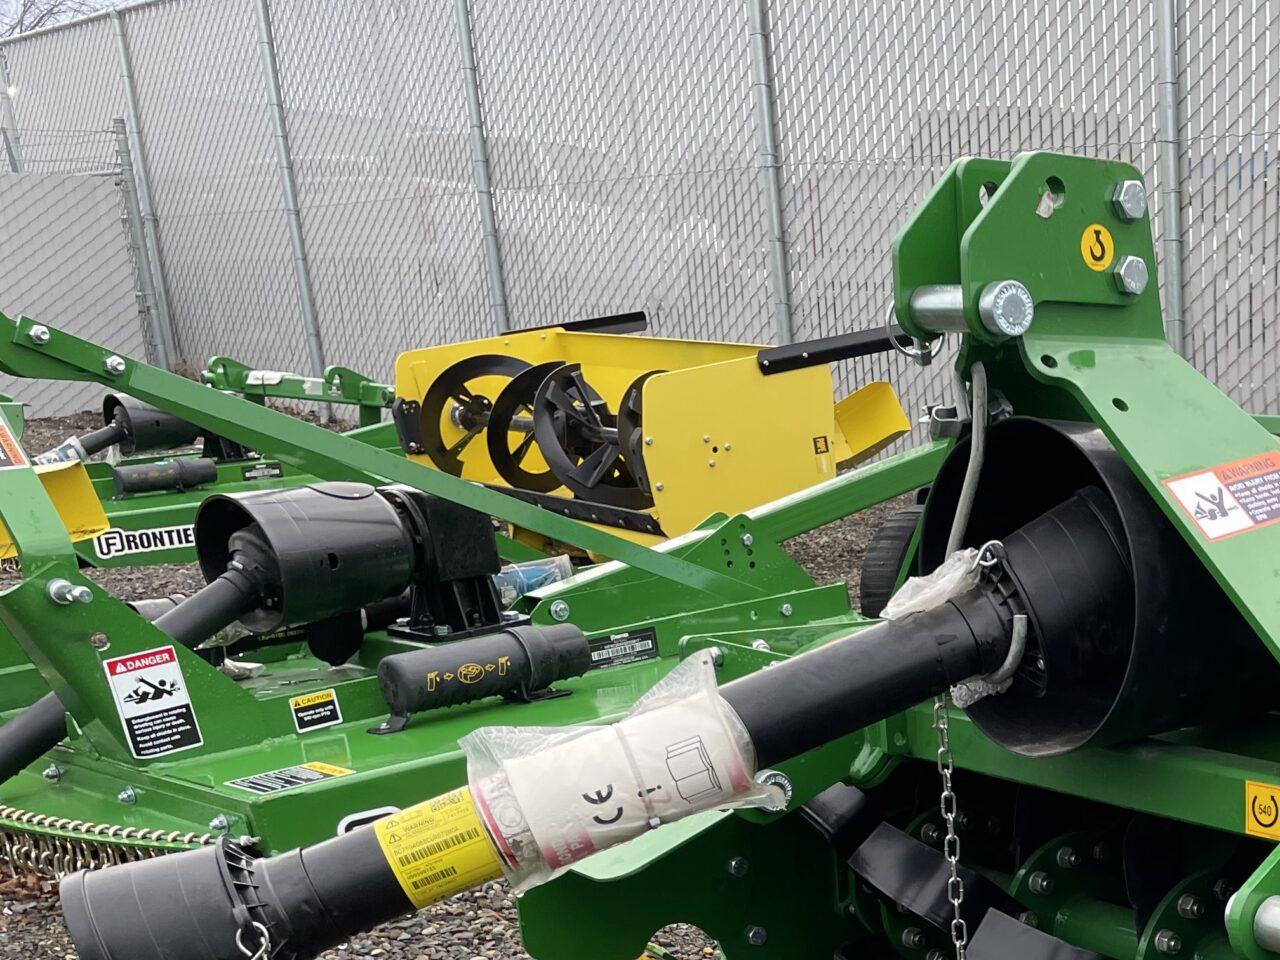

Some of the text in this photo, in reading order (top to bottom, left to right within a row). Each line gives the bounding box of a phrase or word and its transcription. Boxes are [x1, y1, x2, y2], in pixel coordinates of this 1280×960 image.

[1232, 458, 1275, 477] WARNING
[1263, 473, 1280, 481] FROM
[97, 528, 196, 556] FRONTIE
[127, 653, 170, 670] DANGER
[302, 693, 332, 705] CAUTION
[131, 713, 163, 724] Entanglement
[168, 707, 186, 715] rotating
[153, 737, 170, 745] contact
[1259, 804, 1272, 817] 540
